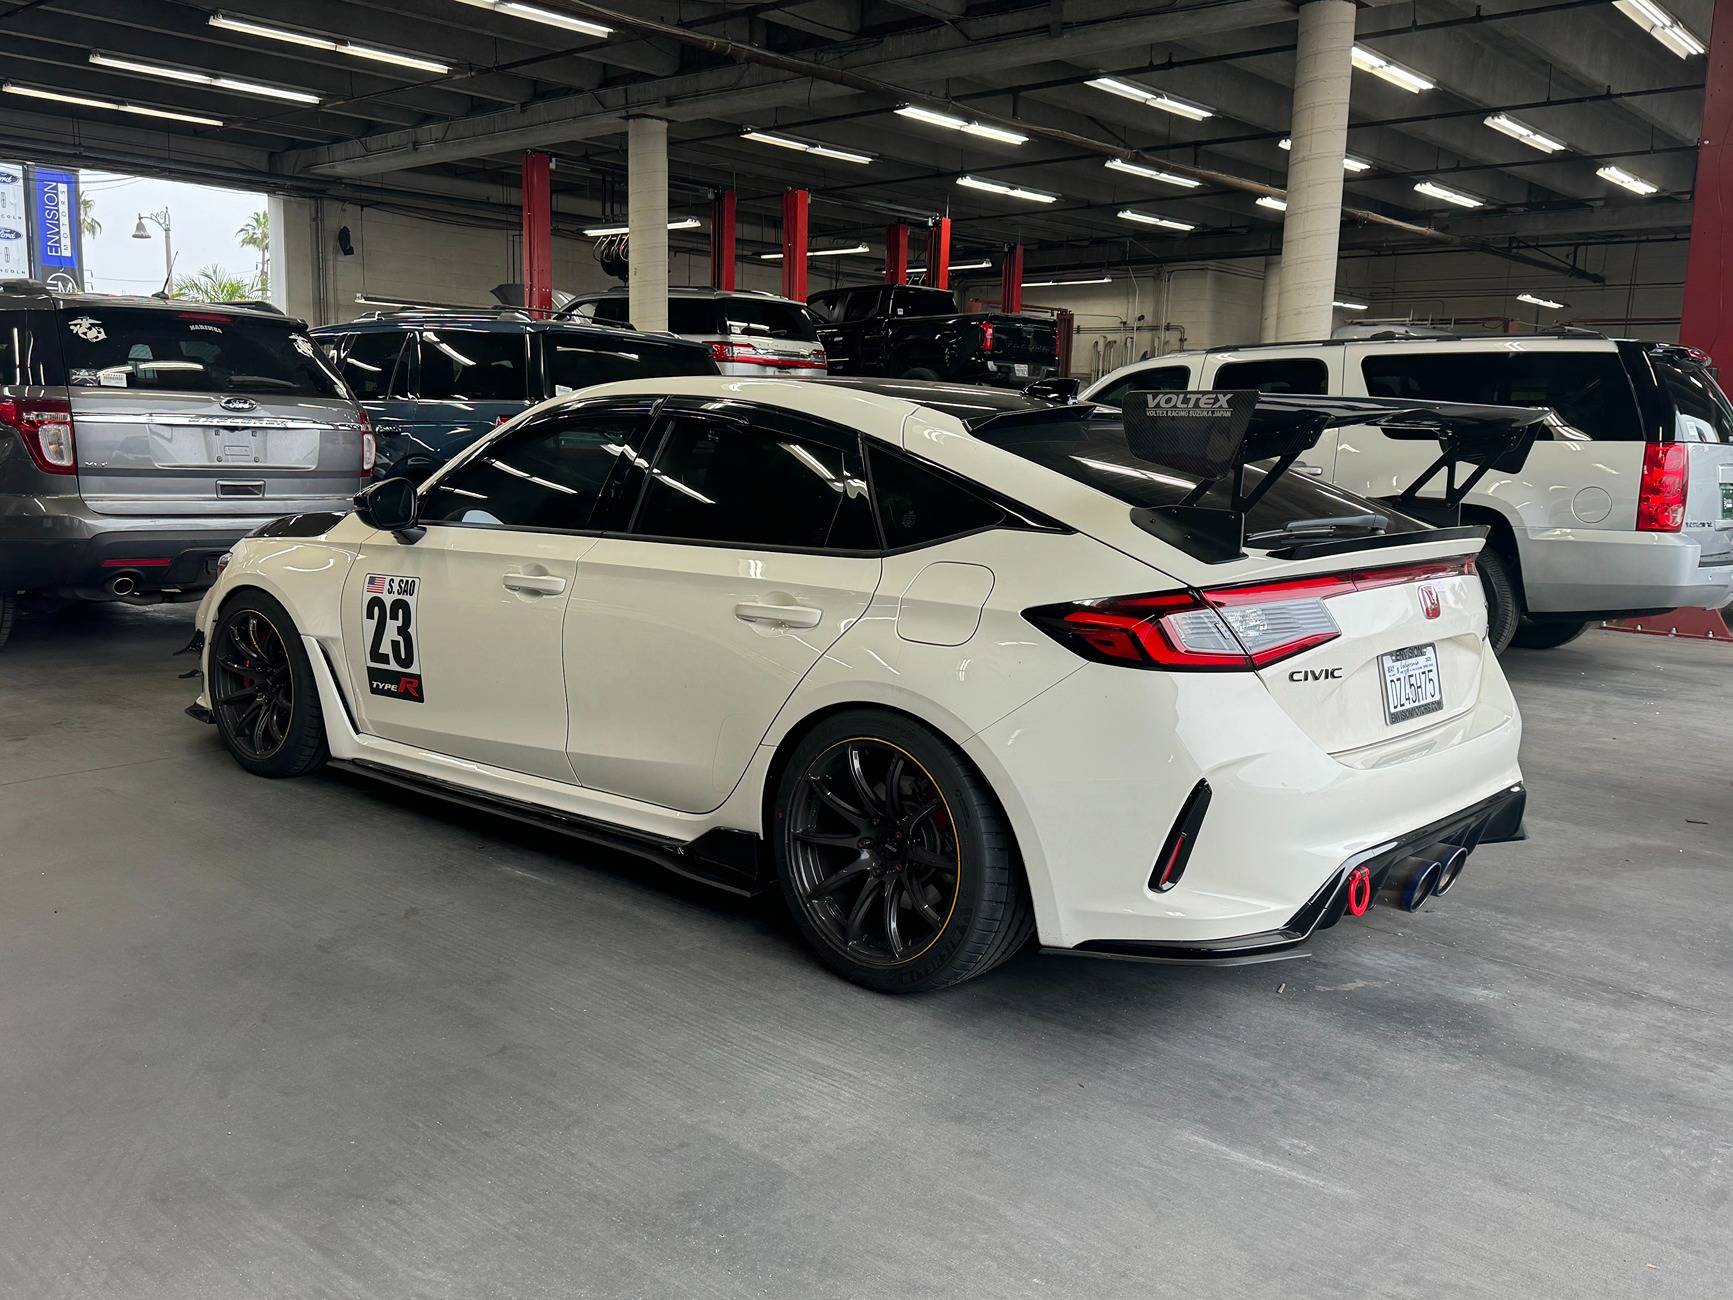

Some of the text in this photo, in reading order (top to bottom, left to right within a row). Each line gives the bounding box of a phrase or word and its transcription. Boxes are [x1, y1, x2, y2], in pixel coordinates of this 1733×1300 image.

[44, 181, 60, 256] ENVISION
[60, 189, 69, 251] MOTORS
[1146, 394, 1233, 408] VOLTEX
[387, 578, 416, 596] S. SAO
[366, 596, 414, 669] 23
[1288, 667, 1343, 682] CIVIC
[372, 677, 419, 697] TYPE R
